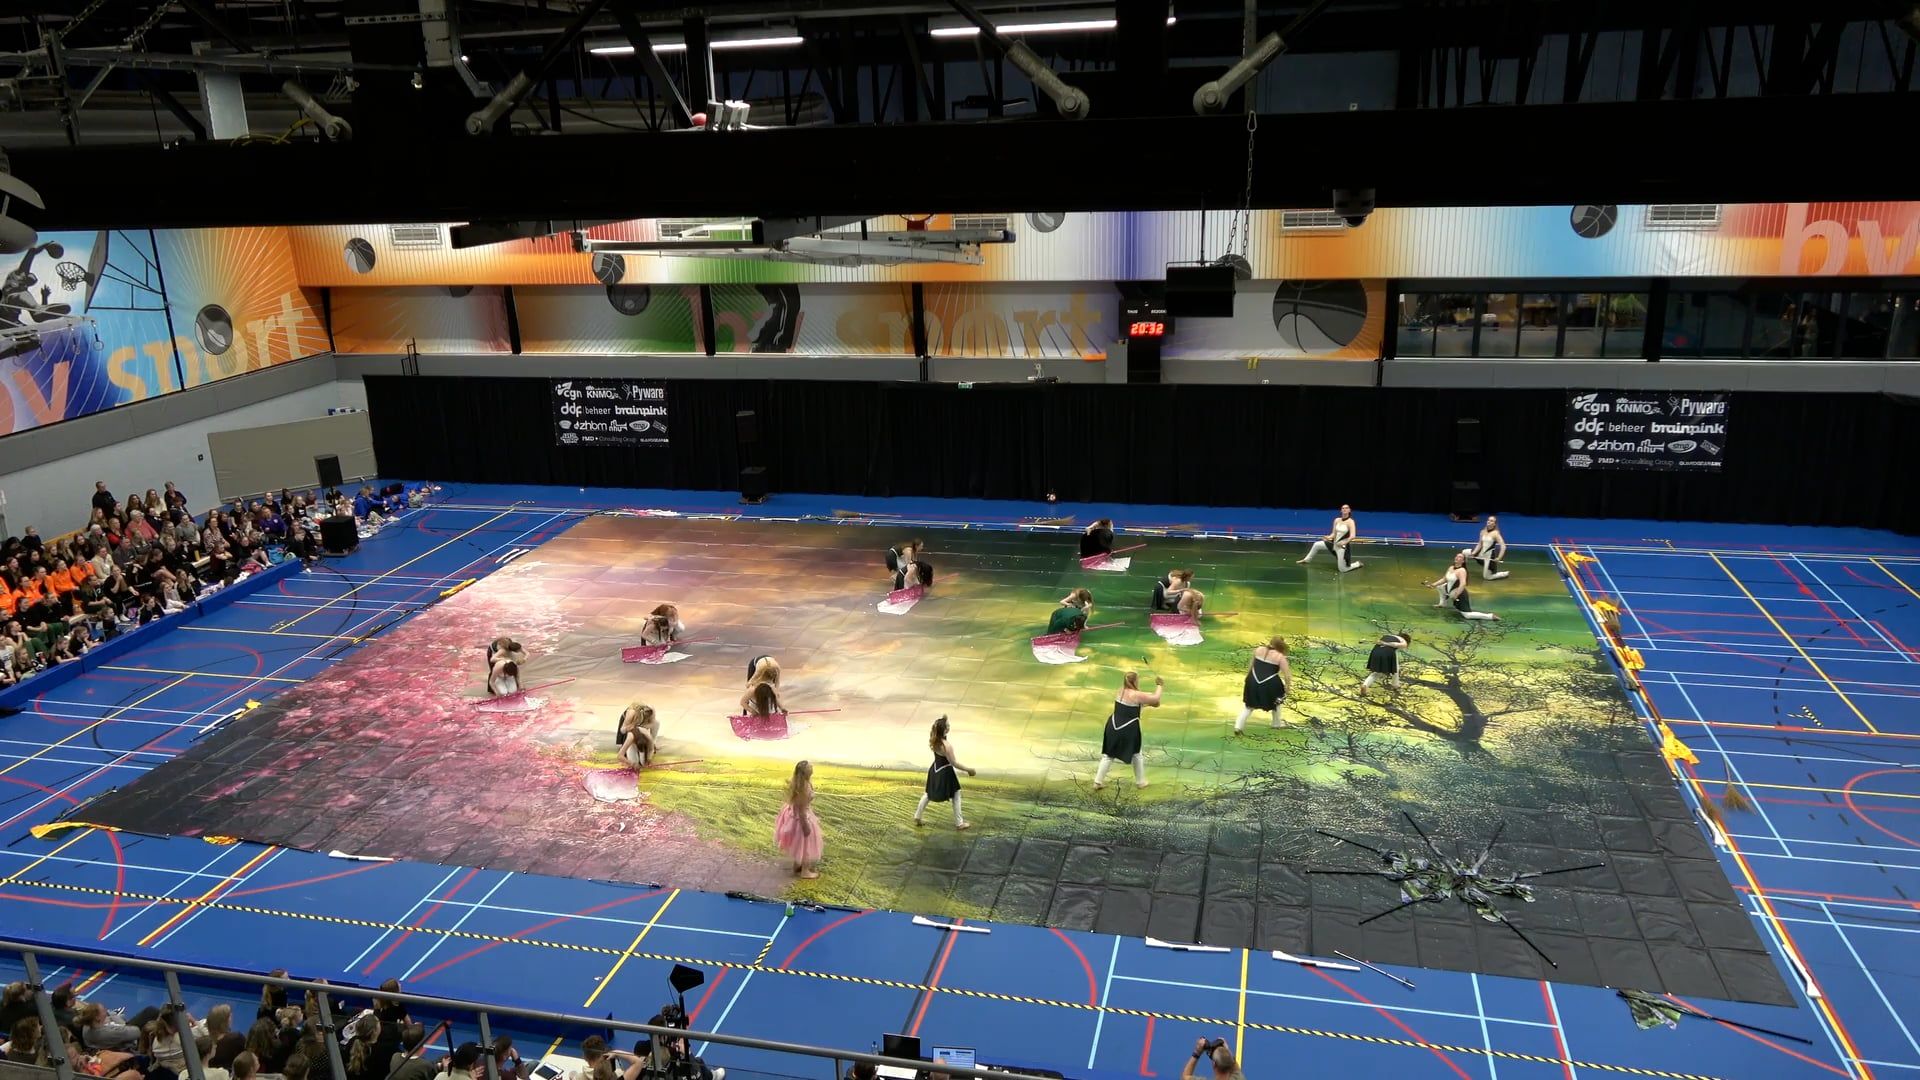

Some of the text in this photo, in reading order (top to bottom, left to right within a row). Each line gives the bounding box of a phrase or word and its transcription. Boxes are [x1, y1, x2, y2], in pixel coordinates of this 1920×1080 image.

[1130, 322, 1164, 335] 20:32
[563, 390, 583, 400] cgn
[586, 390, 613, 399] KNMO
[632, 385, 664, 400] Pyware
[560, 402, 668, 418] ddf beheer brainpink
[1583, 403, 1610, 415] cgn
[1616, 404, 1652, 413] KNMO
[1680, 398, 1725, 416] Pyware
[1574, 417, 1725, 436] ddf beheer brainpink
